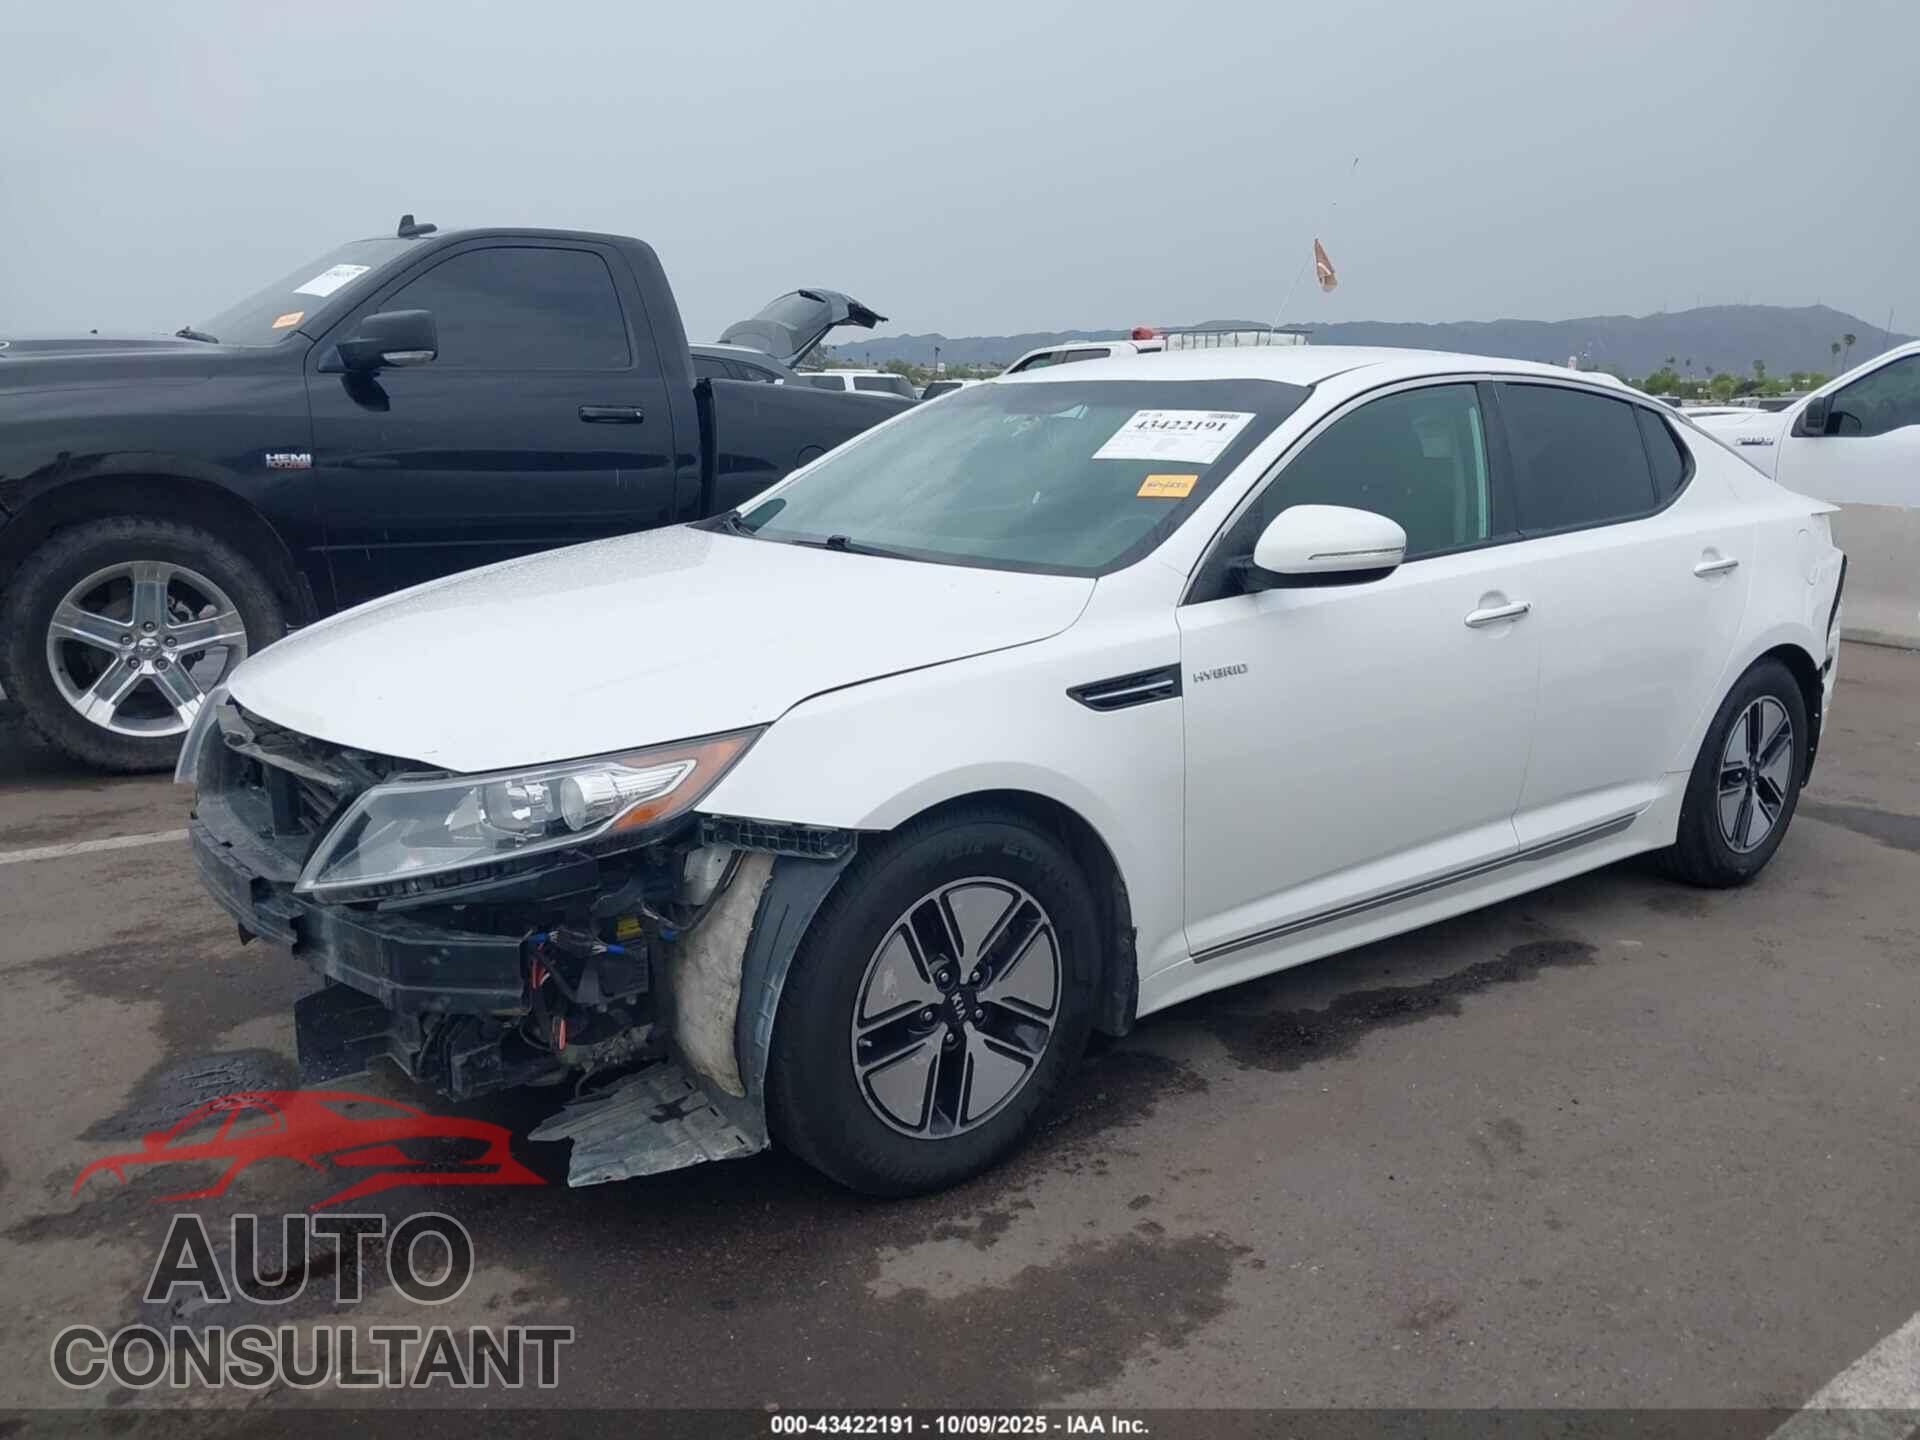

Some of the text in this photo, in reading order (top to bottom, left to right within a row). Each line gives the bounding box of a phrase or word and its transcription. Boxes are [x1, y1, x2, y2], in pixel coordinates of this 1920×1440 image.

[1133, 419, 1228, 432] 43422191
[265, 453, 312, 463] HEMI
[1192, 663, 1248, 683] HYBRID
